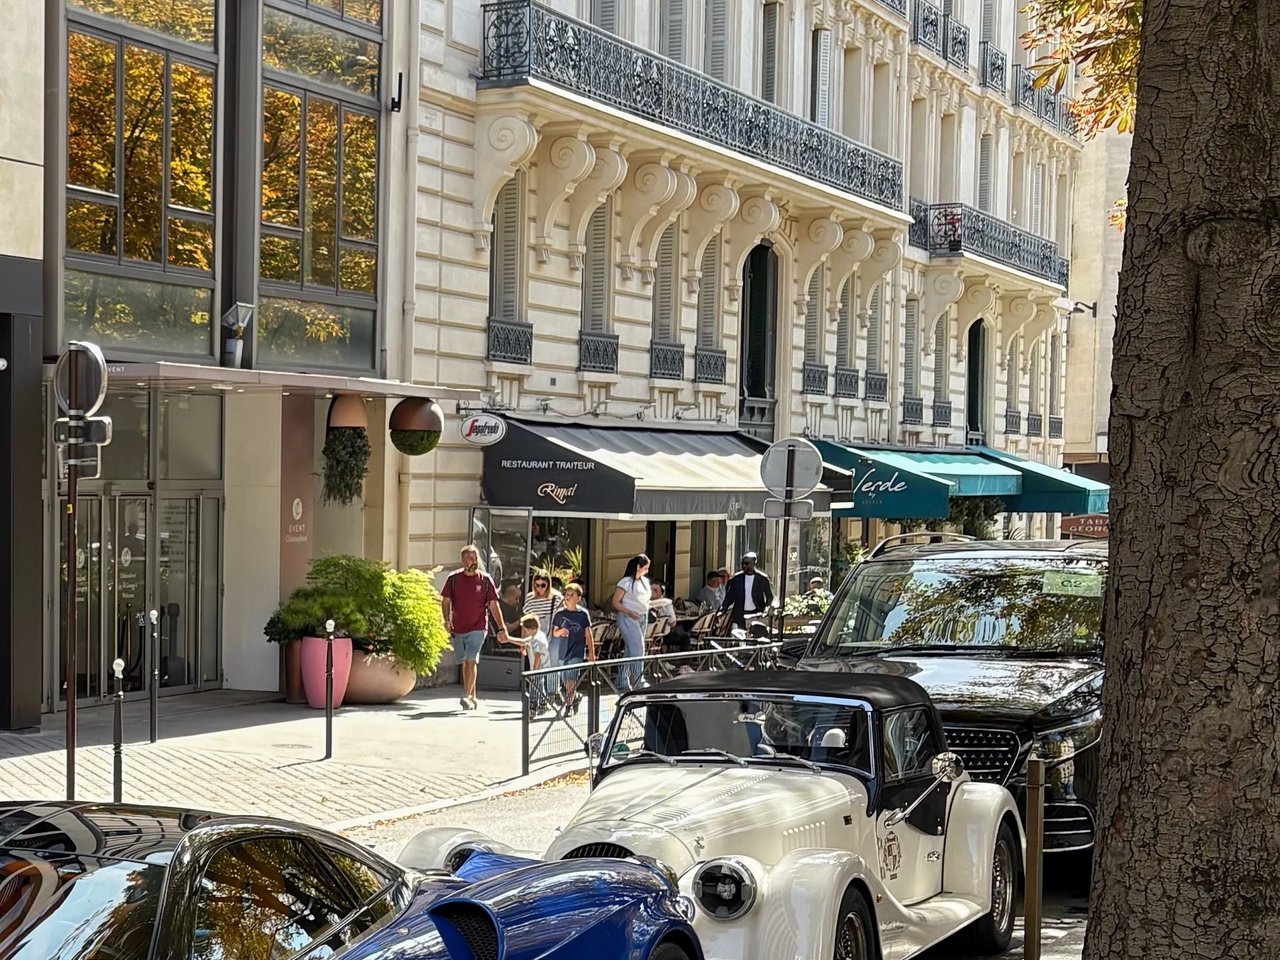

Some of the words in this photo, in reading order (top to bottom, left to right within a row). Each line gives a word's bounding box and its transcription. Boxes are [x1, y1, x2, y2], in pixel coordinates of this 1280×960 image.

[501, 460, 553, 469] RESTAURANT
[556, 461, 595, 470] TRAITEUR
[853, 468, 908, 493] Verde
[288, 524, 305, 533] EVENT
